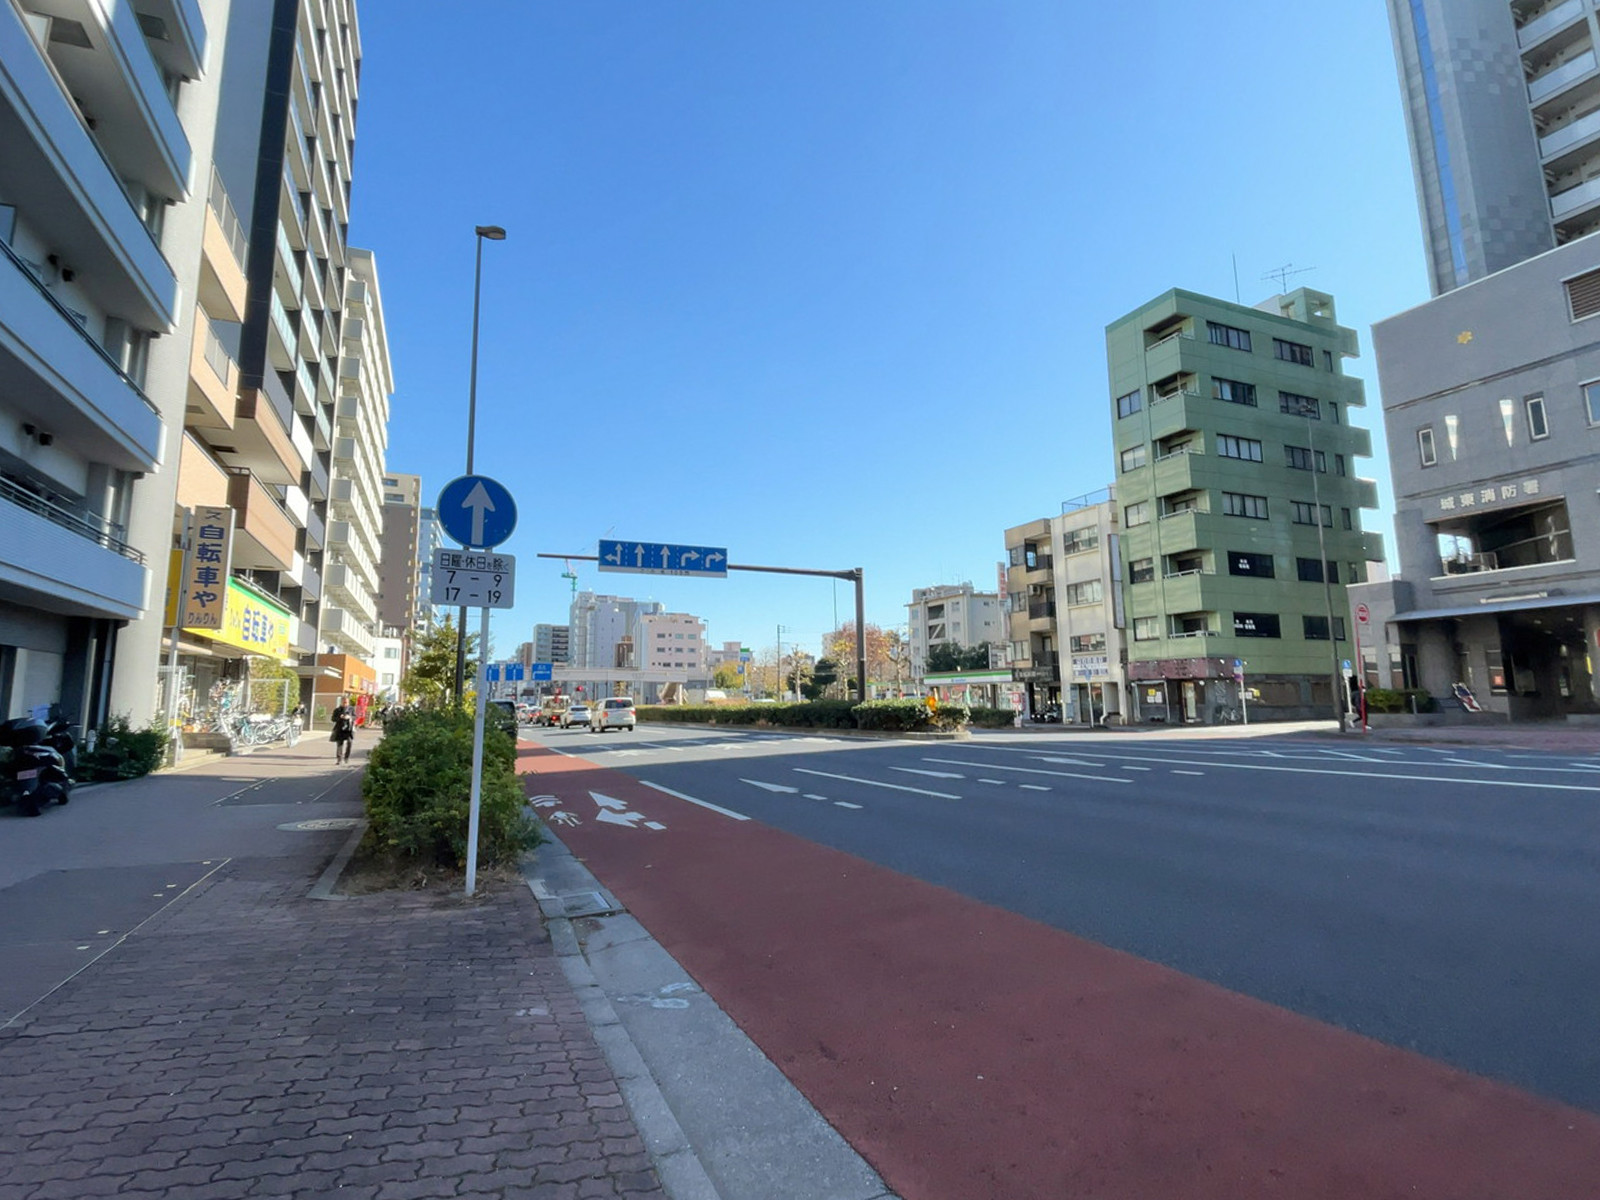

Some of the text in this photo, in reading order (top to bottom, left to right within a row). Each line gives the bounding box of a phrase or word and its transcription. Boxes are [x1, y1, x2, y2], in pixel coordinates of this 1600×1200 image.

[192, 525, 225, 608] 自転車や
[445, 587, 460, 601] 17
[487, 590, 502, 604] 19
[188, 612, 217, 624] りんりん
